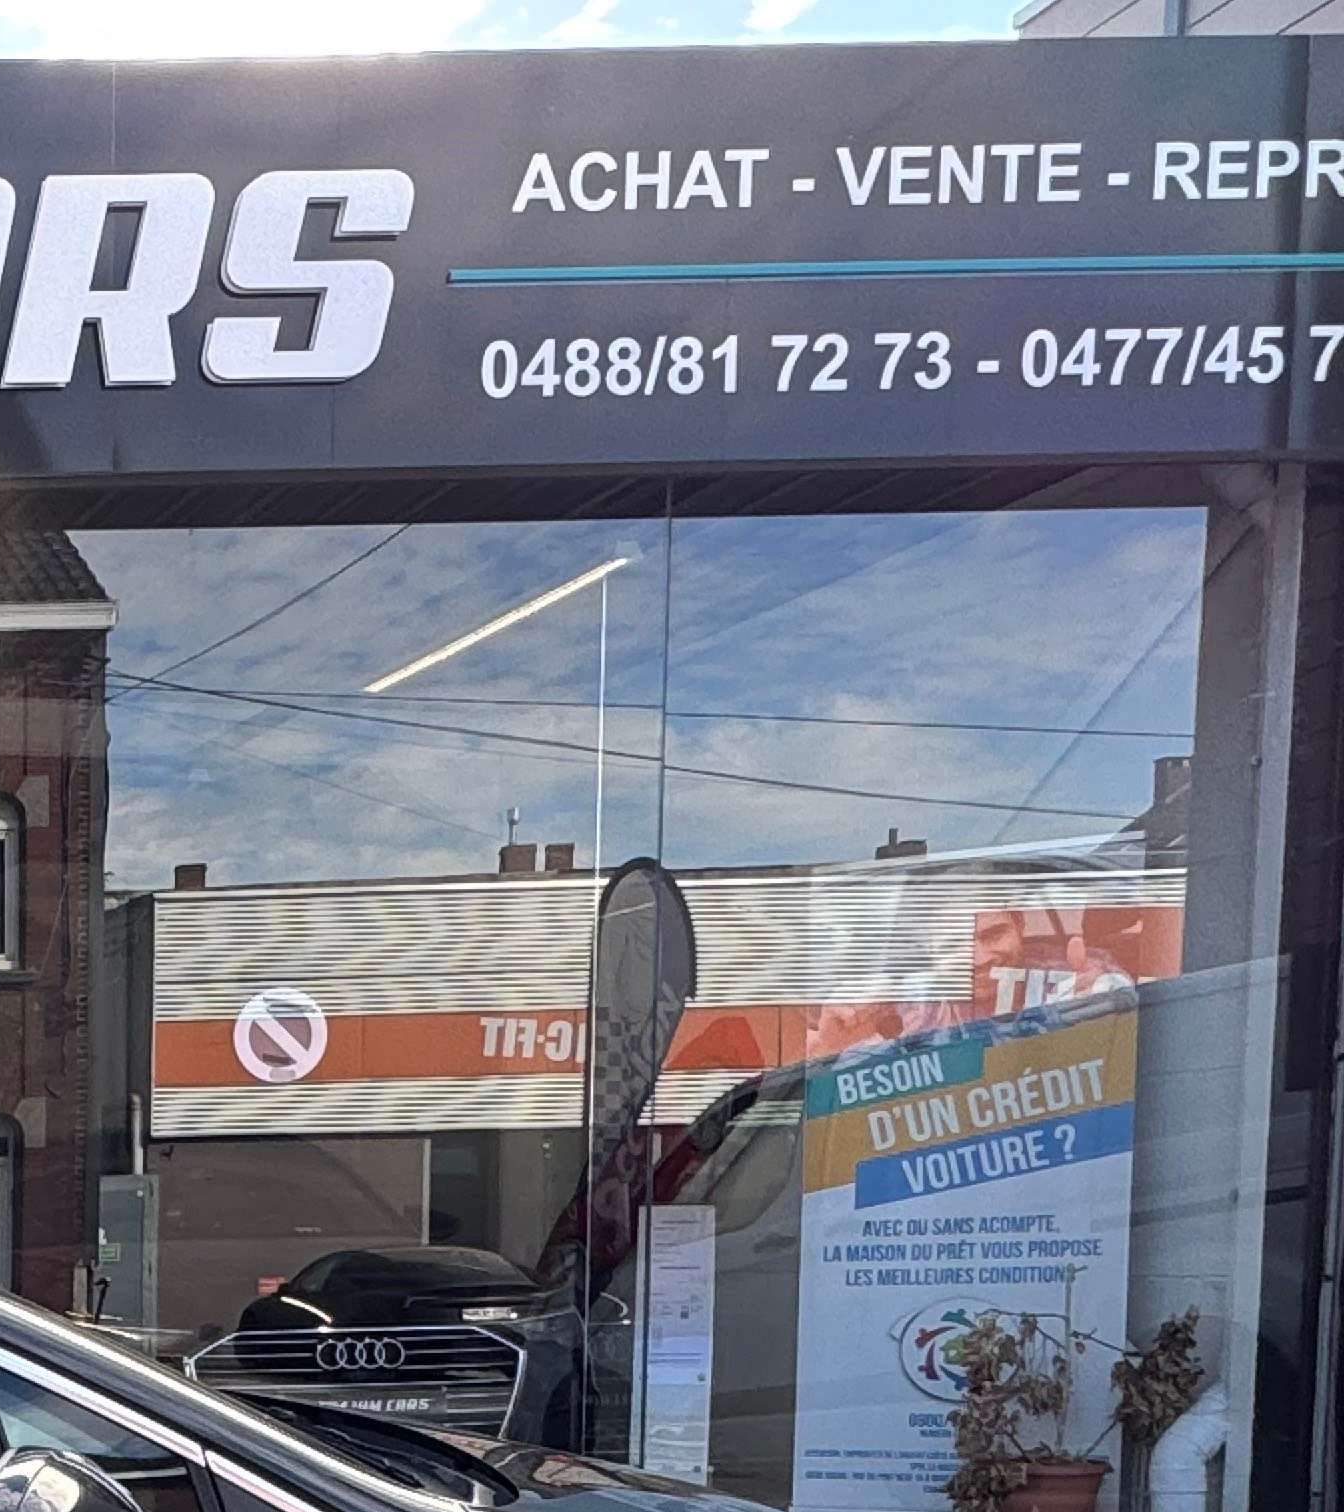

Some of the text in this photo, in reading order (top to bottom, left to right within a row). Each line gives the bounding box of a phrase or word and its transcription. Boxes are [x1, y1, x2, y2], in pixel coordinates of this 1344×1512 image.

[512, 148, 770, 213] ACHAT
[837, 142, 1082, 207] VENTE
[1152, 138, 1344, 200] REPR
[481, 334, 739, 400] 0488/81
[771, 332, 849, 394] 72
[874, 330, 952, 392] 73
[1021, 325, 1285, 388] 0477/45
[836, 1051, 945, 1106] BESOIN
[966, 1058, 1105, 1128] CRÉDIT
[901, 1130, 1050, 1194] VOITURE
[823, 1245, 843, 1263] LA
[846, 1243, 907, 1262] MAISON
[911, 1243, 933, 1261] DU
[980, 1240, 1023, 1259] VOUS
[1027, 1238, 1103, 1258] PROPOSE
[862, 1219, 904, 1238] AVEC
[906, 1218, 929, 1236] OU
[932, 1217, 975, 1235] SANS
[845, 1265, 1074, 1287] LES MEILLEURES CONDITION
